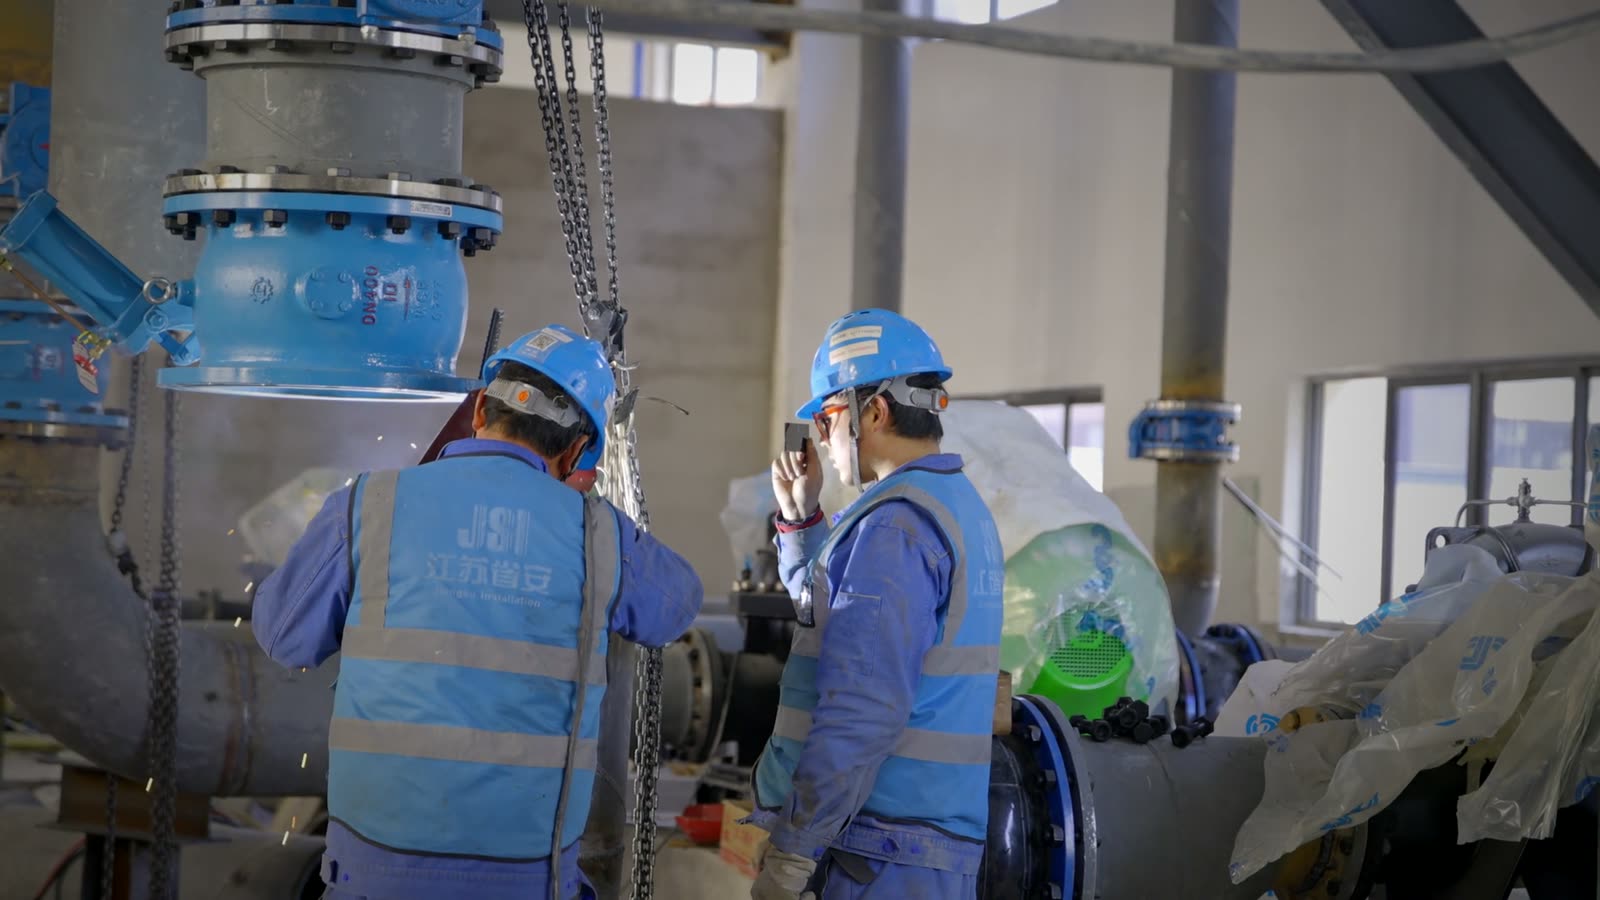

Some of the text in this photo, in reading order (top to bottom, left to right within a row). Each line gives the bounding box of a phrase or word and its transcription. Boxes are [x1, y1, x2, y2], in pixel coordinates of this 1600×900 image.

[362, 265, 379, 325] DN400
[457, 503, 531, 556] JSI
[424, 552, 553, 596] 江苏省安
